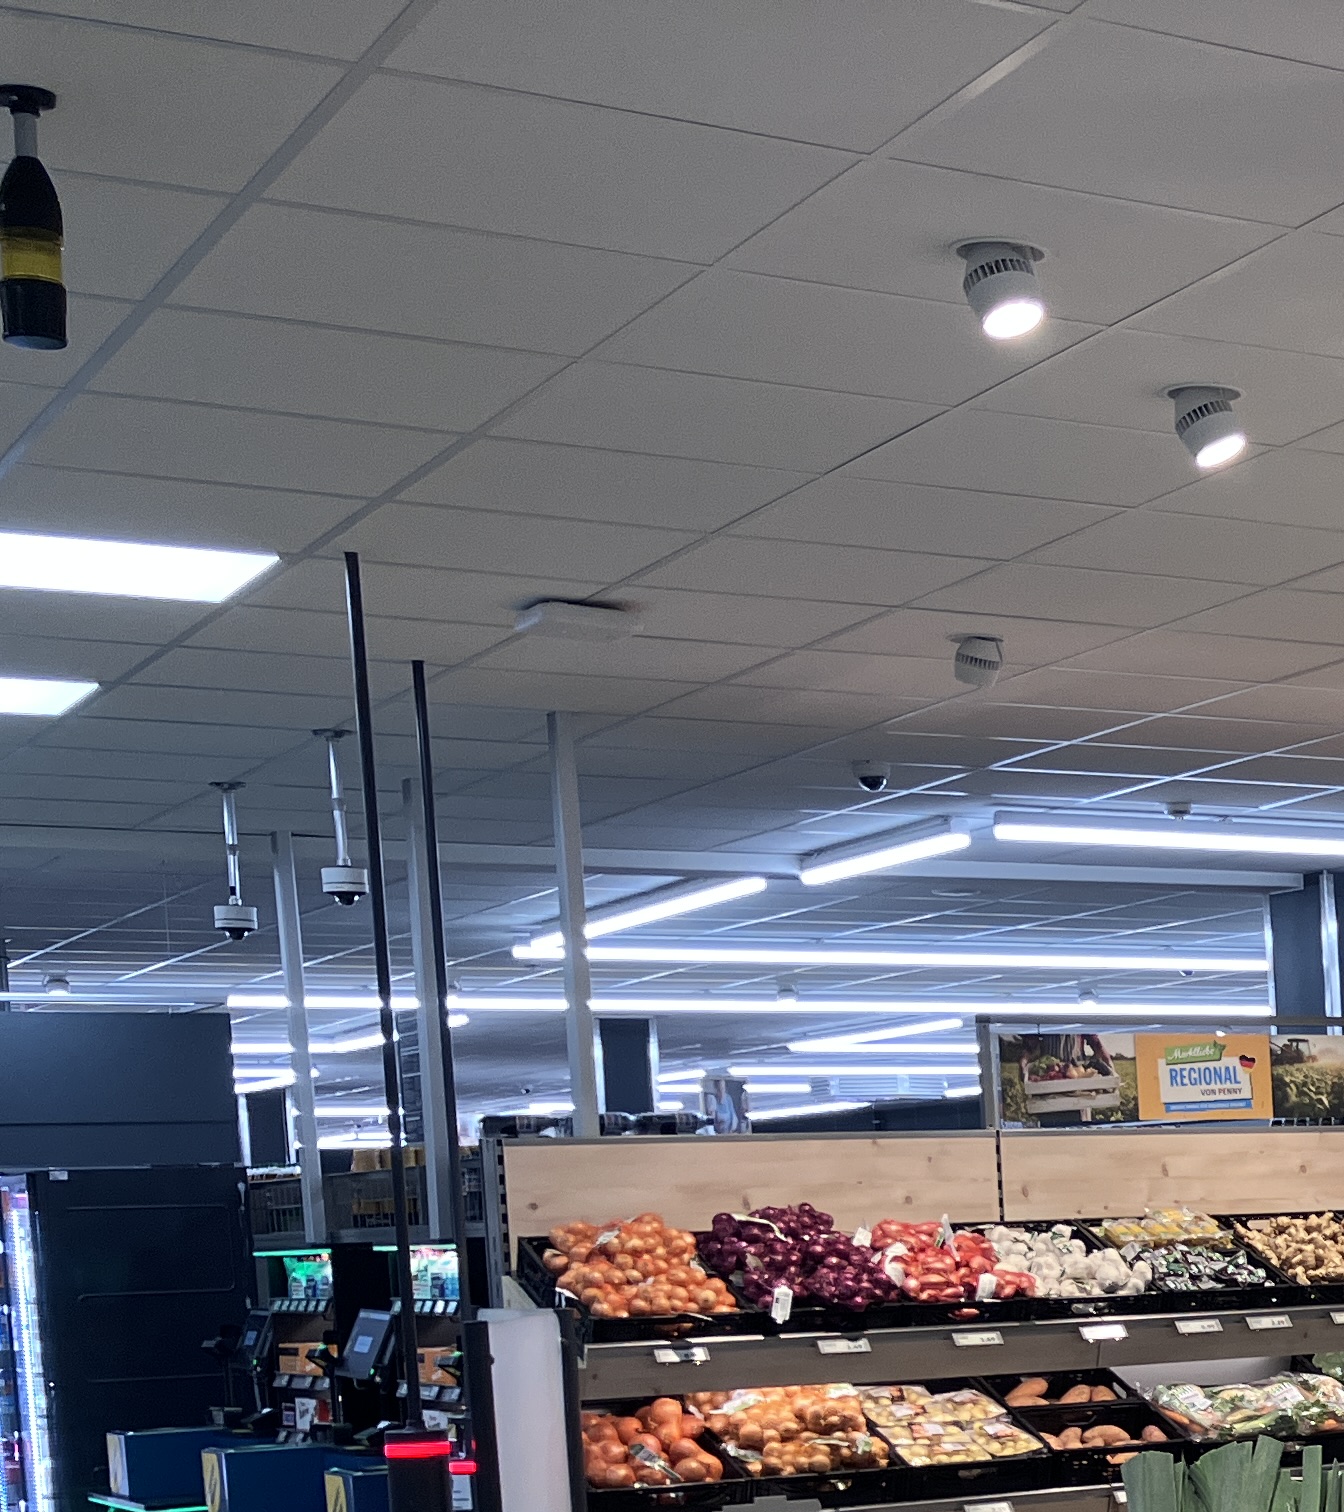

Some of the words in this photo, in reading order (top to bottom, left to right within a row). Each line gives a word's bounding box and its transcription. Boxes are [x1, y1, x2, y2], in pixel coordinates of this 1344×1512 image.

[1169, 1065, 1241, 1087] REGIONAL
[1201, 1088, 1217, 1097] VON
[1218, 1087, 1242, 1096] PENNY
